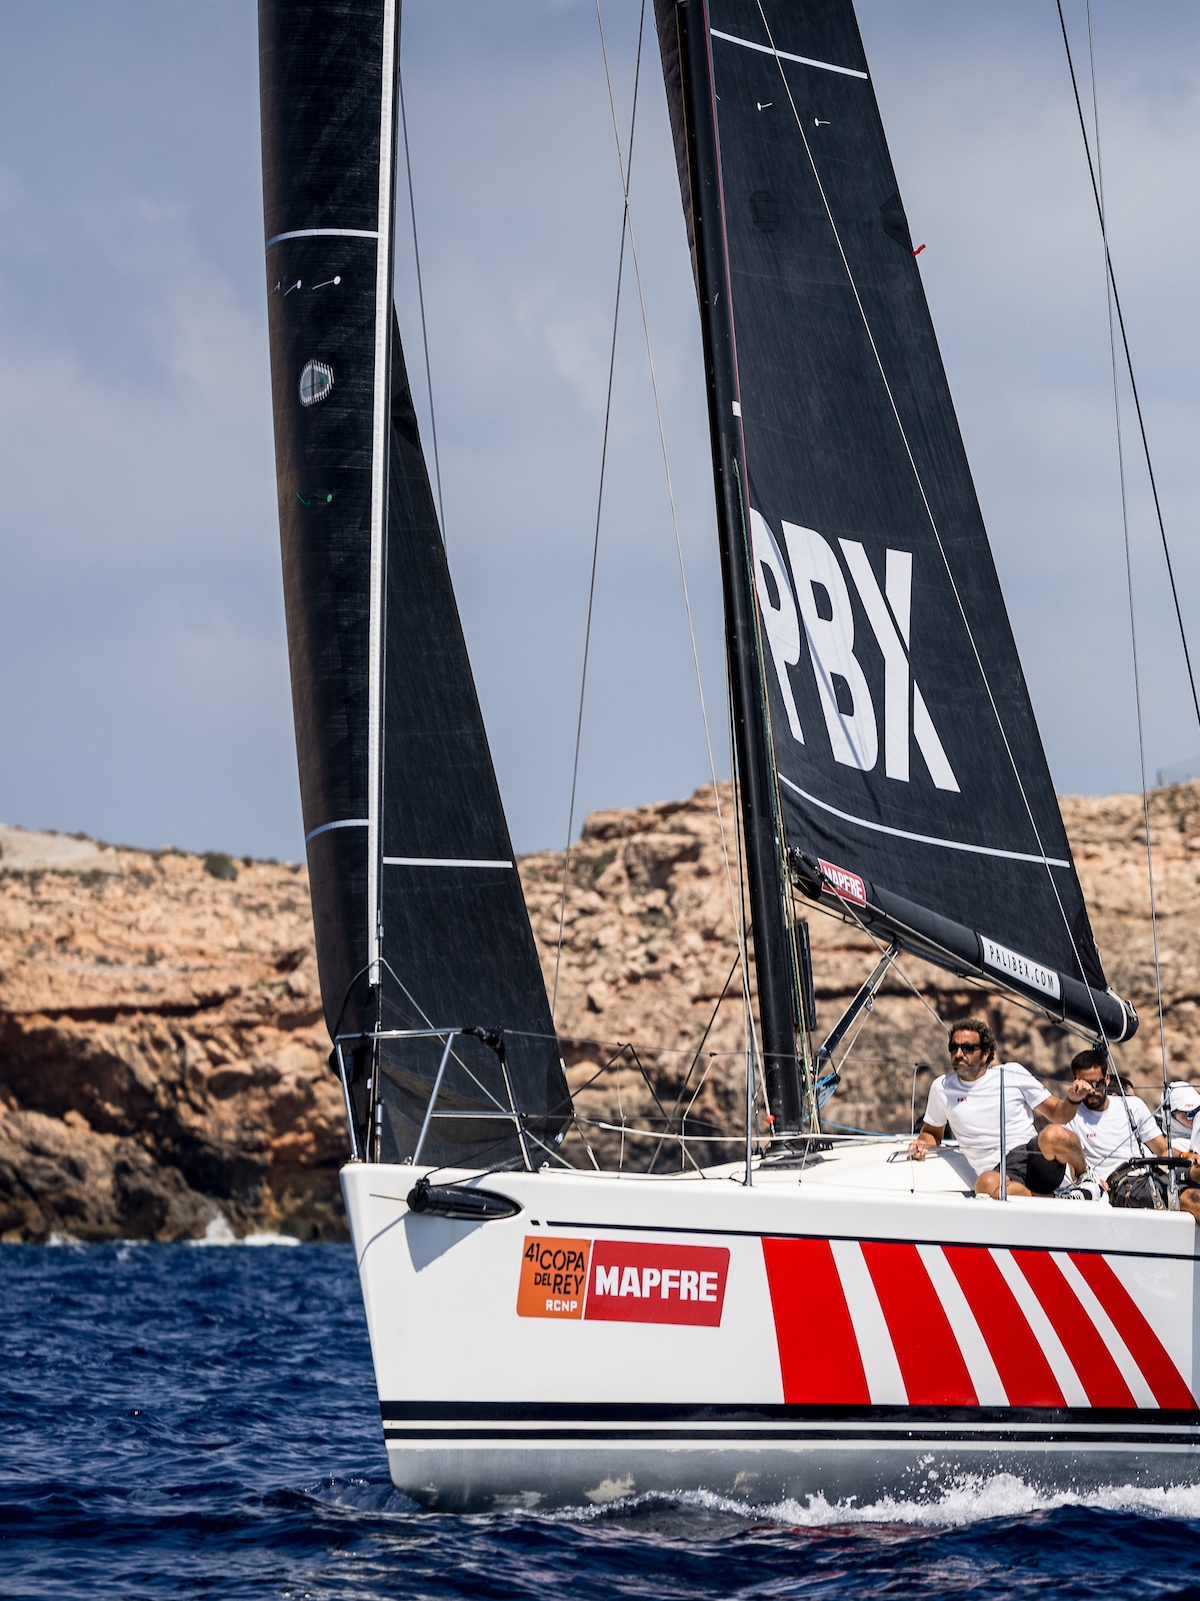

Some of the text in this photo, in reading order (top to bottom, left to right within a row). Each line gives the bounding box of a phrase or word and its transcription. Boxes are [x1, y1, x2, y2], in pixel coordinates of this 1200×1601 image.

[749, 506, 961, 793] PBX
[823, 866, 863, 900] MAPFRE
[989, 945, 1054, 991] PALIBEX.COM
[525, 1243, 585, 1272] 41 COPA
[534, 1272, 584, 1295] DEL REY
[595, 1265, 718, 1302] MAPFRE
[545, 1299, 578, 1312] RCNP
